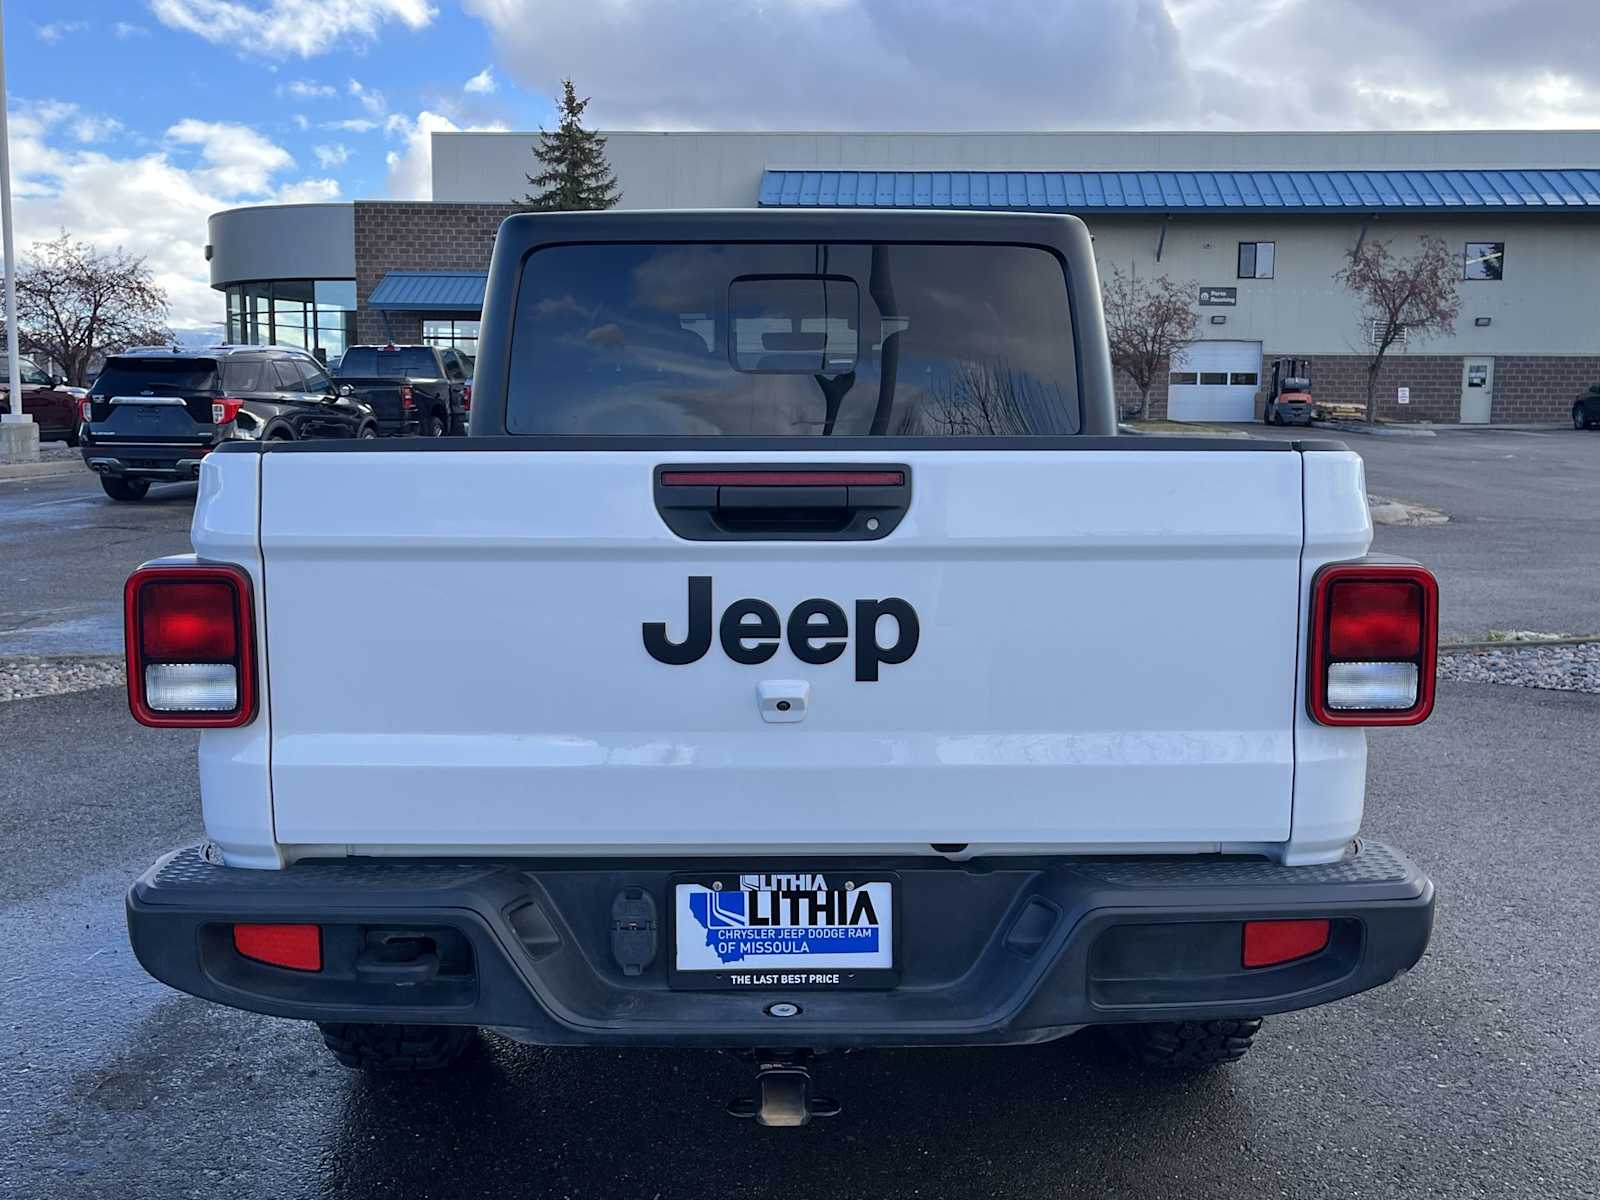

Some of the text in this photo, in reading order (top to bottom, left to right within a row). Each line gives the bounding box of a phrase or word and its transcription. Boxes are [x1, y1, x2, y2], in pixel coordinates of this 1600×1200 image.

[642, 576, 920, 682] Jeep
[760, 874, 828, 891] LITHIA
[749, 891, 879, 926] LITHIA
[718, 928, 872, 940] CHRYSLER JEEP DODGE RAM
[718, 941, 810, 954] OF MISSOULA
[730, 974, 840, 985] THE LAST BEST PRICE
